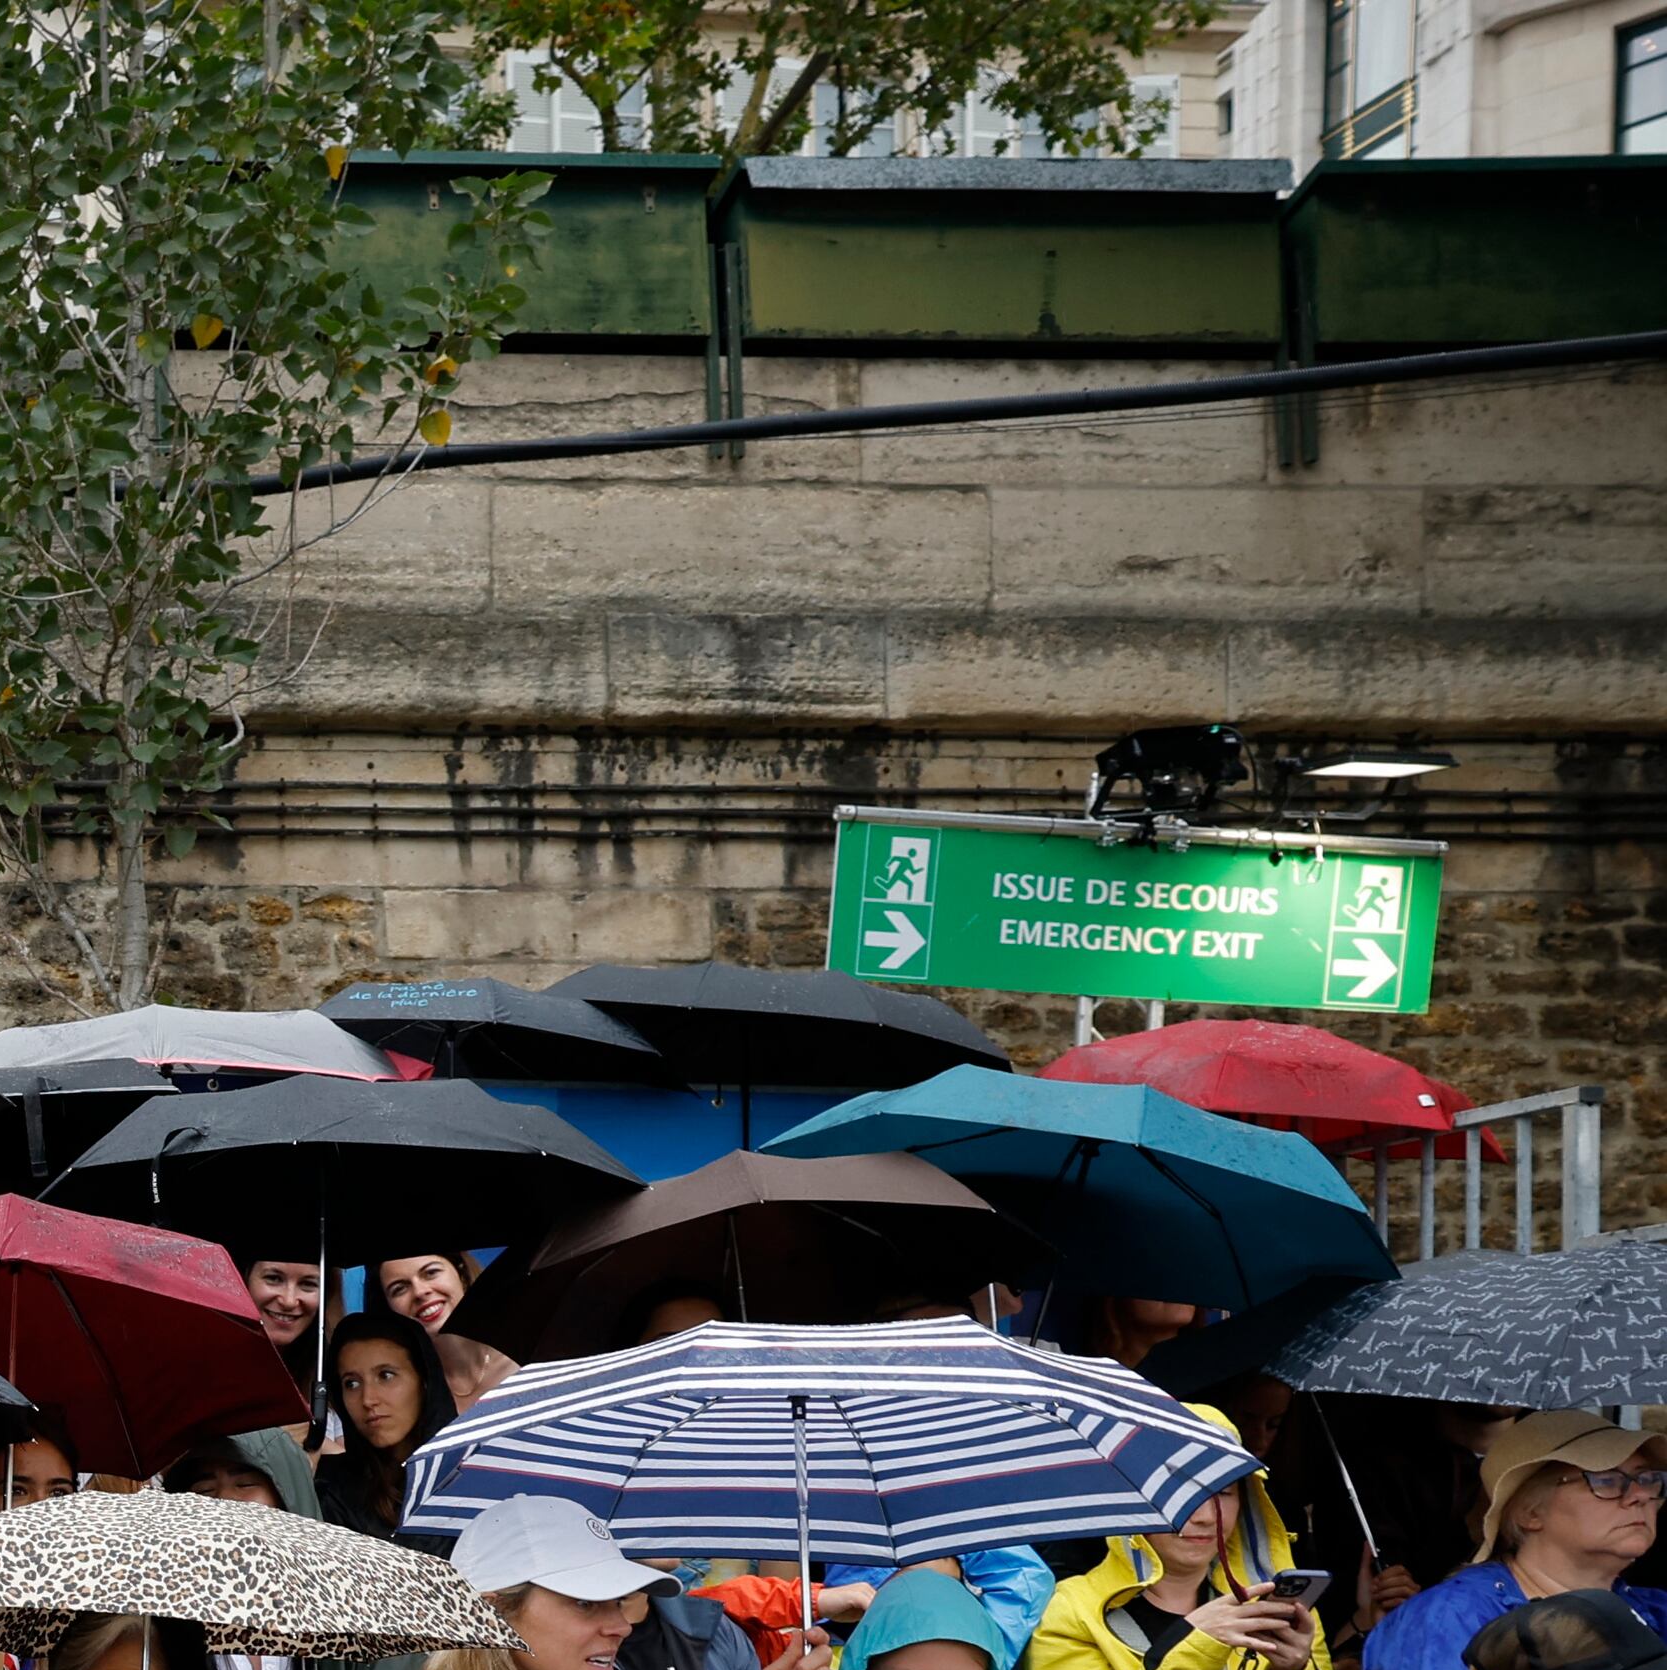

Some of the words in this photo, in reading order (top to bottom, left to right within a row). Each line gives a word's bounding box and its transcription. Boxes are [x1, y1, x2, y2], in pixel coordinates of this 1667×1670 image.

[992, 872, 1074, 902] ISSUE
[1086, 879, 1127, 906] DE
[1134, 882, 1279, 915] SECOURS
[999, 919, 1186, 955] EMERGENCY
[1192, 930, 1264, 960] EXIT
[349, 992, 371, 1000] de
[378, 991, 392, 999] la
